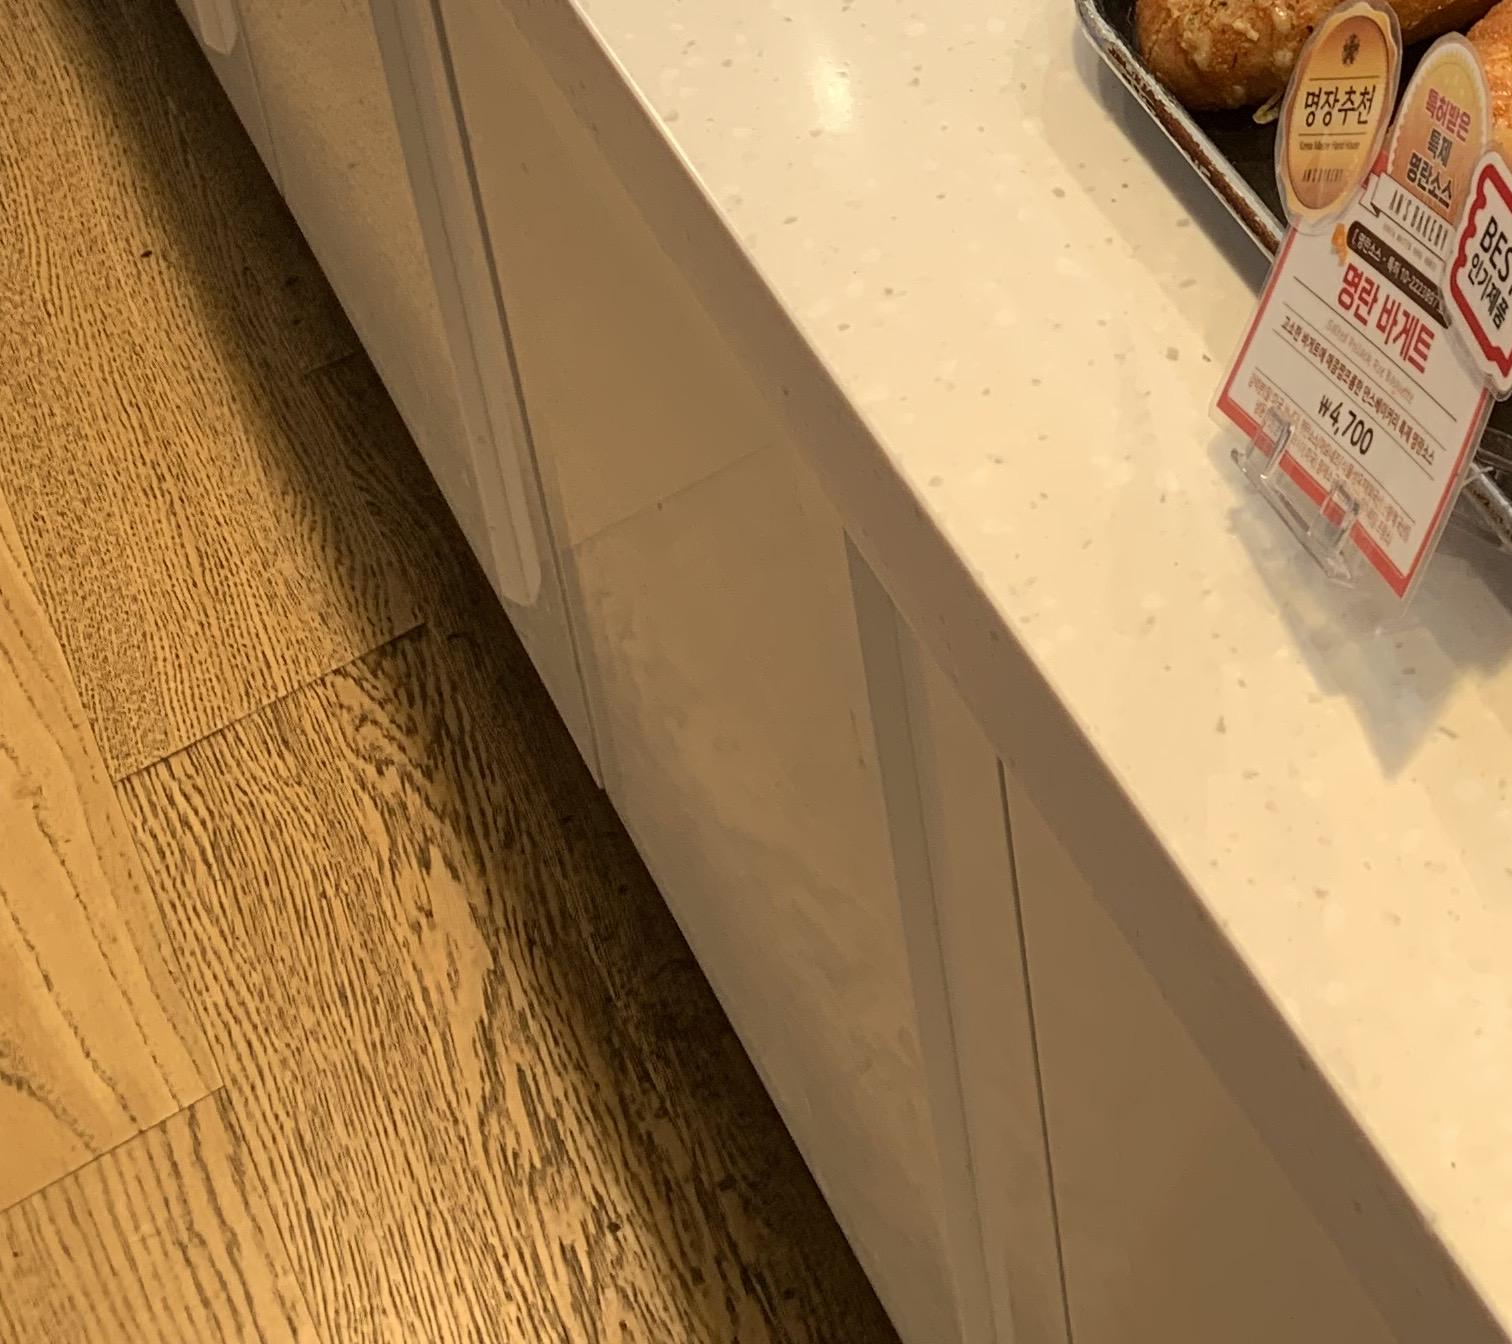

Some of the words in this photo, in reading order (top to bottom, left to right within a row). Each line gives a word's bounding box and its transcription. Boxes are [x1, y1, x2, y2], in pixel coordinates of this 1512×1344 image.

[1304, 84, 1377, 127] 명장추천
[1425, 88, 1472, 143] 특허받은
[1407, 152, 1452, 209] 명란소스
[1338, 262, 1380, 327] 명란
[1376, 294, 1436, 375] 바게트
[1468, 253, 1509, 331] 인기제품
[1318, 394, 1374, 456] ₩4,700
